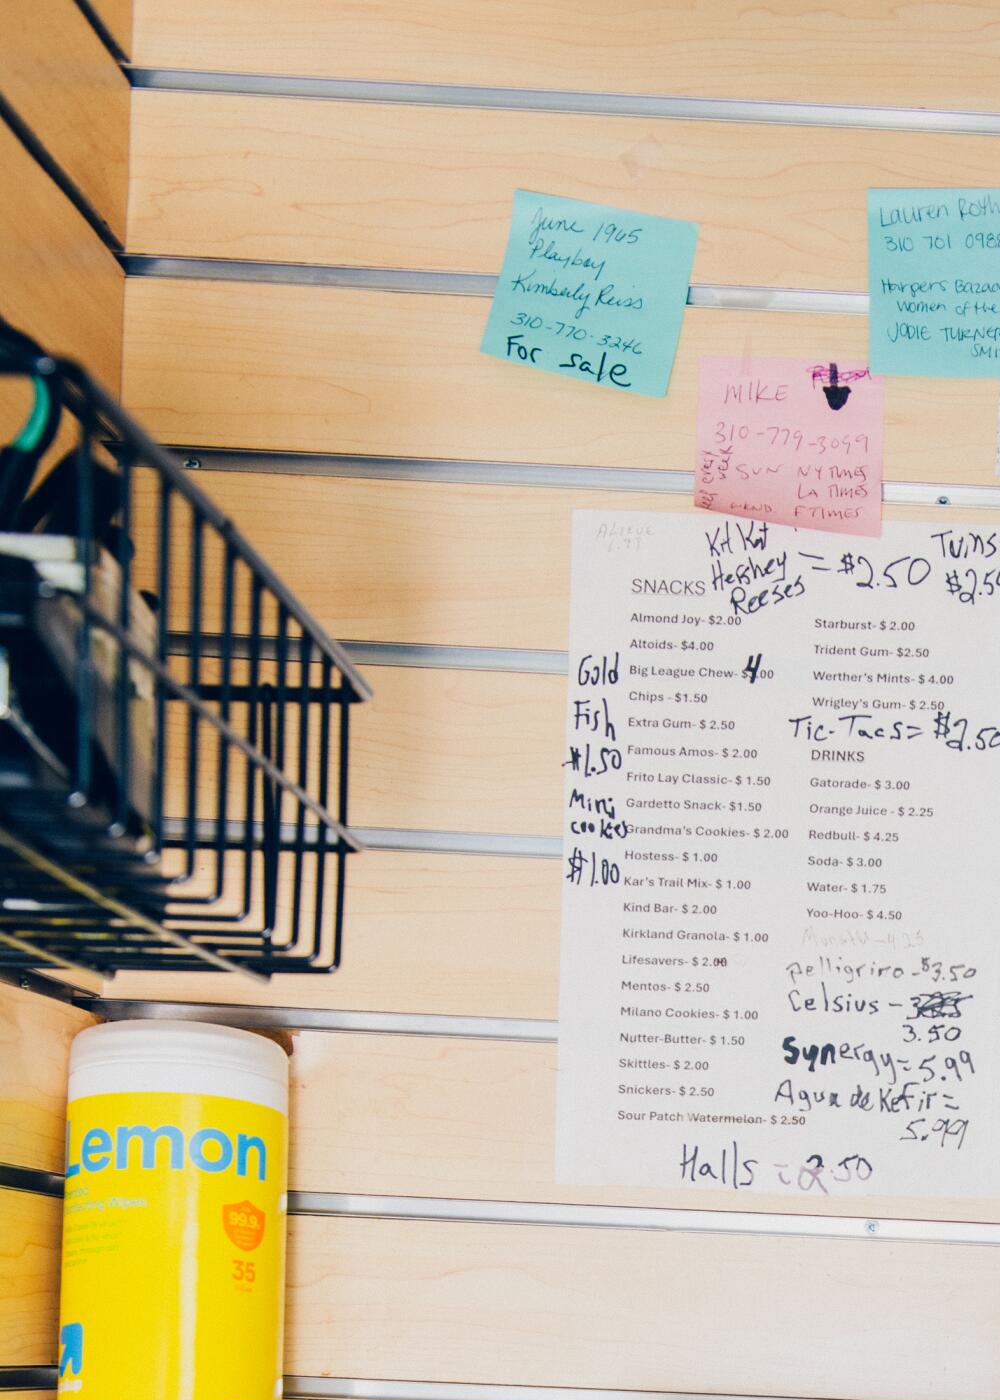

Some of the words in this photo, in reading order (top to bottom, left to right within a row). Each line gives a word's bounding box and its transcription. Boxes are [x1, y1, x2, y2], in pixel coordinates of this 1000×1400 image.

[880, 204, 949, 227] Lauren
[529, 207, 584, 245] June
[593, 222, 643, 244] 1965
[884, 236, 914, 251] 310
[923, 234, 951, 249] 701
[528, 240, 606, 281] Playboy
[511, 269, 590, 320] Kimberly
[975, 300, 998, 314] the
[887, 322, 931, 343] JODIE
[506, 334, 543, 363] For
[559, 352, 632, 387] sale
[723, 380, 790, 405] MIKE
[735, 464, 784, 480] SUN
[797, 466, 822, 480] NY
[797, 485, 818, 499] LA
[711, 551, 787, 591] Hershey
[837, 552, 932, 589] $2.50
[631, 578, 706, 596] SNACKS
[630, 612, 679, 625] Almond
[708, 615, 742, 626] $2.00
[680, 641, 714, 652] $4.00
[813, 644, 857, 657] Trident
[896, 647, 930, 659] $2.50
[577, 652, 620, 686] Gold
[629, 665, 648, 678] Big
[651, 666, 696, 679] League
[812, 671, 874, 683] Werther's
[629, 691, 664, 705] Chips
[675, 693, 708, 704] $1.50
[812, 696, 869, 711] Wrigley's
[573, 697, 617, 741] Fish
[628, 717, 659, 729] Extra
[627, 745, 676, 757] Famous
[811, 749, 865, 762] DRINKS
[626, 772, 654, 783] Frito
[658, 774, 679, 785] Lay
[626, 798, 680, 810] Gardetto
[729, 801, 762, 812] $1.50
[809, 803, 854, 817] Orange
[855, 804, 888, 816] Juice
[626, 825, 693, 836] Grandma's
[566, 847, 620, 887] $1.00
[623, 876, 655, 887] Kar's
[658, 877, 684, 888] Trail
[623, 902, 650, 914] Kind
[622, 929, 673, 940] Kirkland
[788, 982, 880, 1015] Celsius
[620, 1007, 662, 1018] Milano
[902, 1024, 961, 1044] 3.50
[774, 1079, 842, 1112] Agua
[617, 1110, 646, 1122] Sour
[649, 1111, 683, 1123] Patch
[900, 1118, 969, 1150] 5.99
[65, 1119, 268, 1182] Lemon
[679, 1140, 759, 1189] Halls
[231, 1260, 256, 1283] 35
